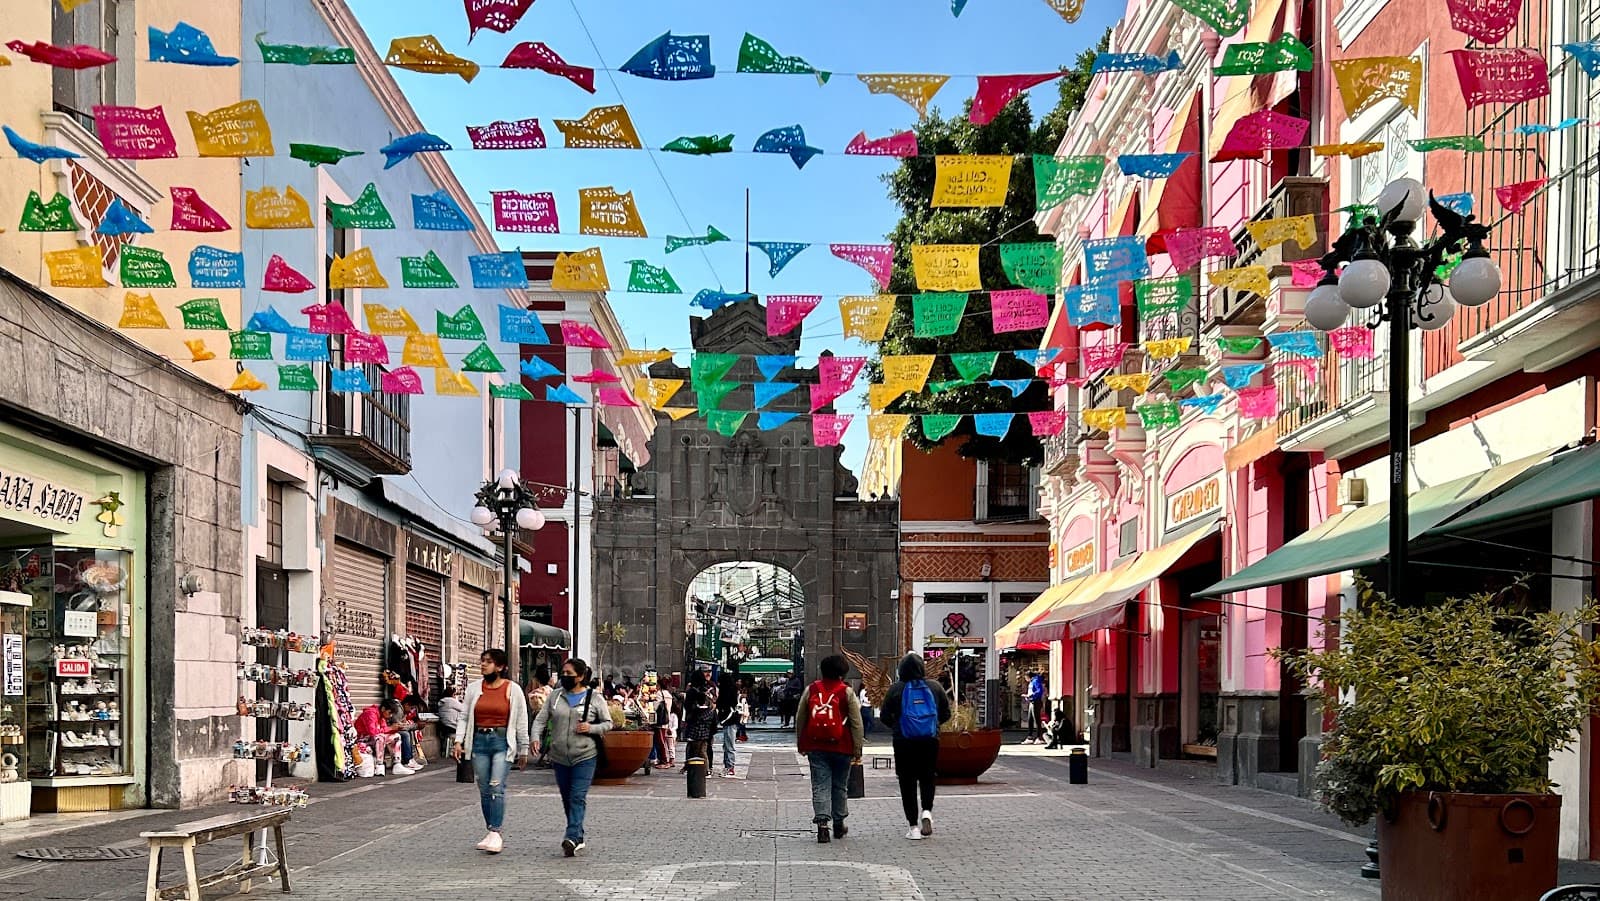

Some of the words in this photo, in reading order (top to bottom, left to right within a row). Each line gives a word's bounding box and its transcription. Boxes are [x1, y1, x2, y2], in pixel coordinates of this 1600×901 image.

[1399, 70, 1411, 81] DE
[122, 138, 156, 149] CALLE
[218, 132, 249, 144] CALLE
[502, 199, 536, 210] DULCES
[512, 211, 540, 221] CALLE
[600, 212, 626, 224] CALLE
[204, 268, 229, 277] CALLE
[0, 472, 33, 511] ANA
[1171, 477, 1219, 523] CARMEN
[1068, 542, 1093, 573] CARMEN
[61, 663, 86, 673] SALIDA
